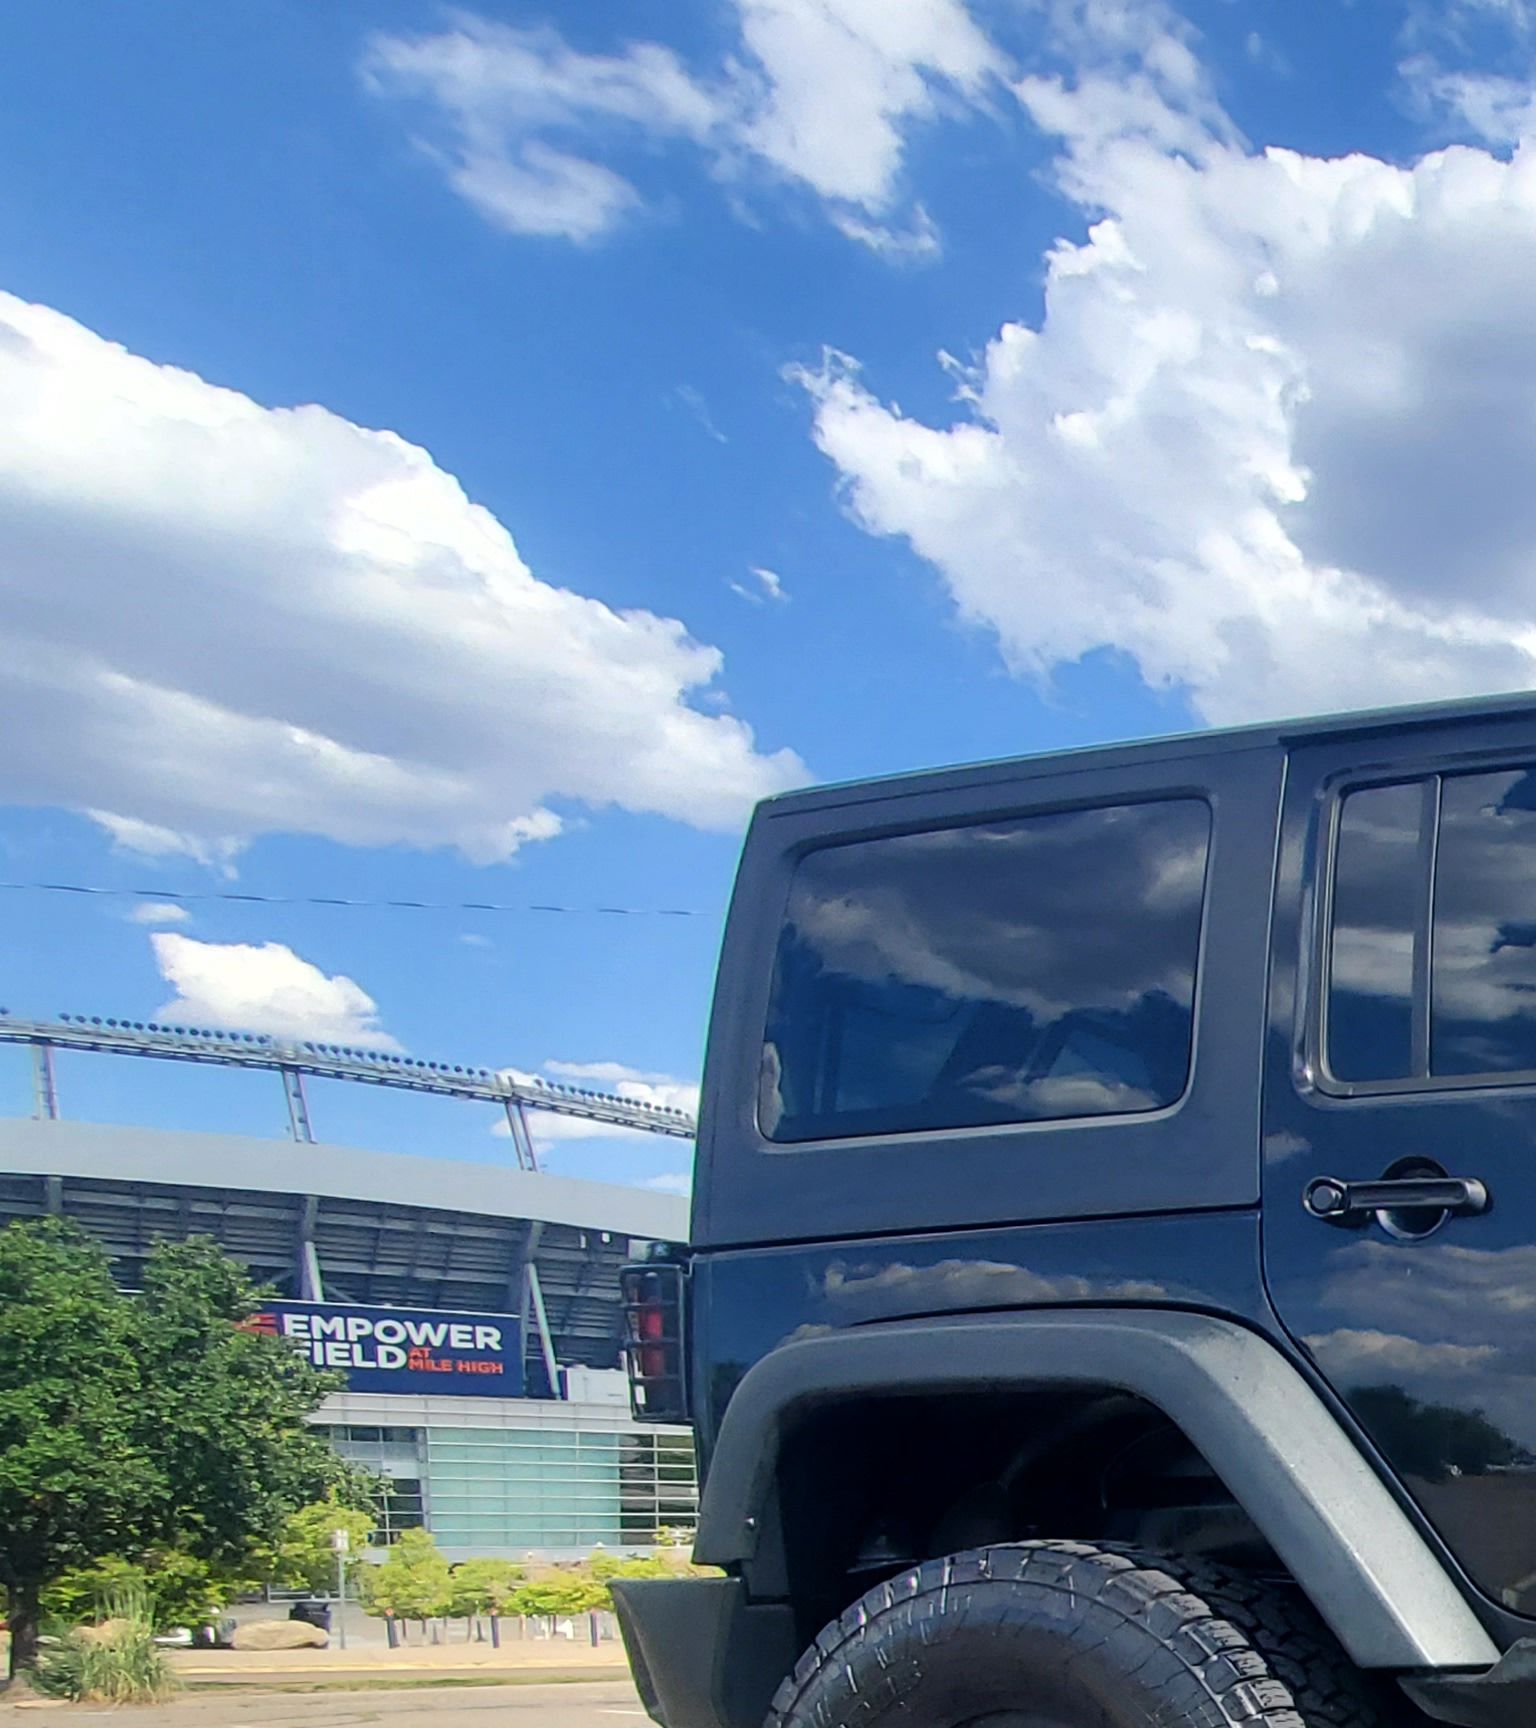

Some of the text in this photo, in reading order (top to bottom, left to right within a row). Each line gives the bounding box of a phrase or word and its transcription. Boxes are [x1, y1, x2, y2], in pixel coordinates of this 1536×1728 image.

[283, 1313, 503, 1351] EMPOWER
[409, 1347, 432, 1359] AT
[408, 1359, 503, 1374] MILE HIGH
